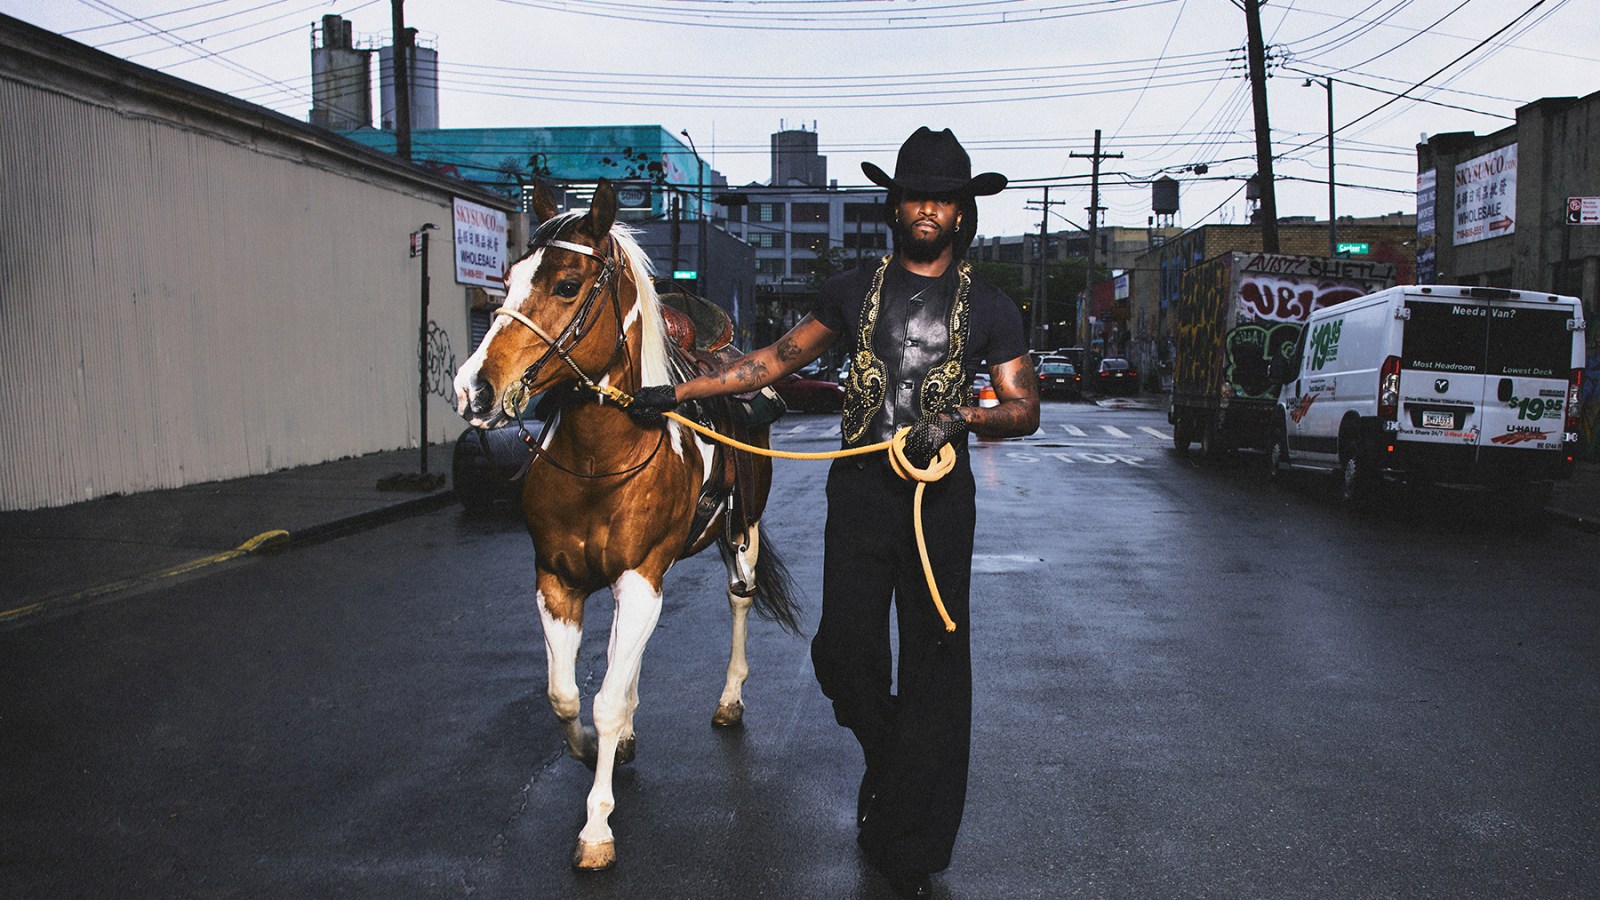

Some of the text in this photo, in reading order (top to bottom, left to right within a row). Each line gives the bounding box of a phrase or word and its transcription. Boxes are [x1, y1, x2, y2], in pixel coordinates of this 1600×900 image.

[1458, 202, 1502, 226] WHOLESALE
[461, 250, 497, 269] WHOLESALE
[1452, 305, 1516, 318] Need a Van?
[1412, 360, 1476, 372] Most Headroom
[1502, 366, 1531, 375] Lowest
[1507, 425, 1541, 433] U-HAUL
[1005, 452, 1148, 468] STOP
